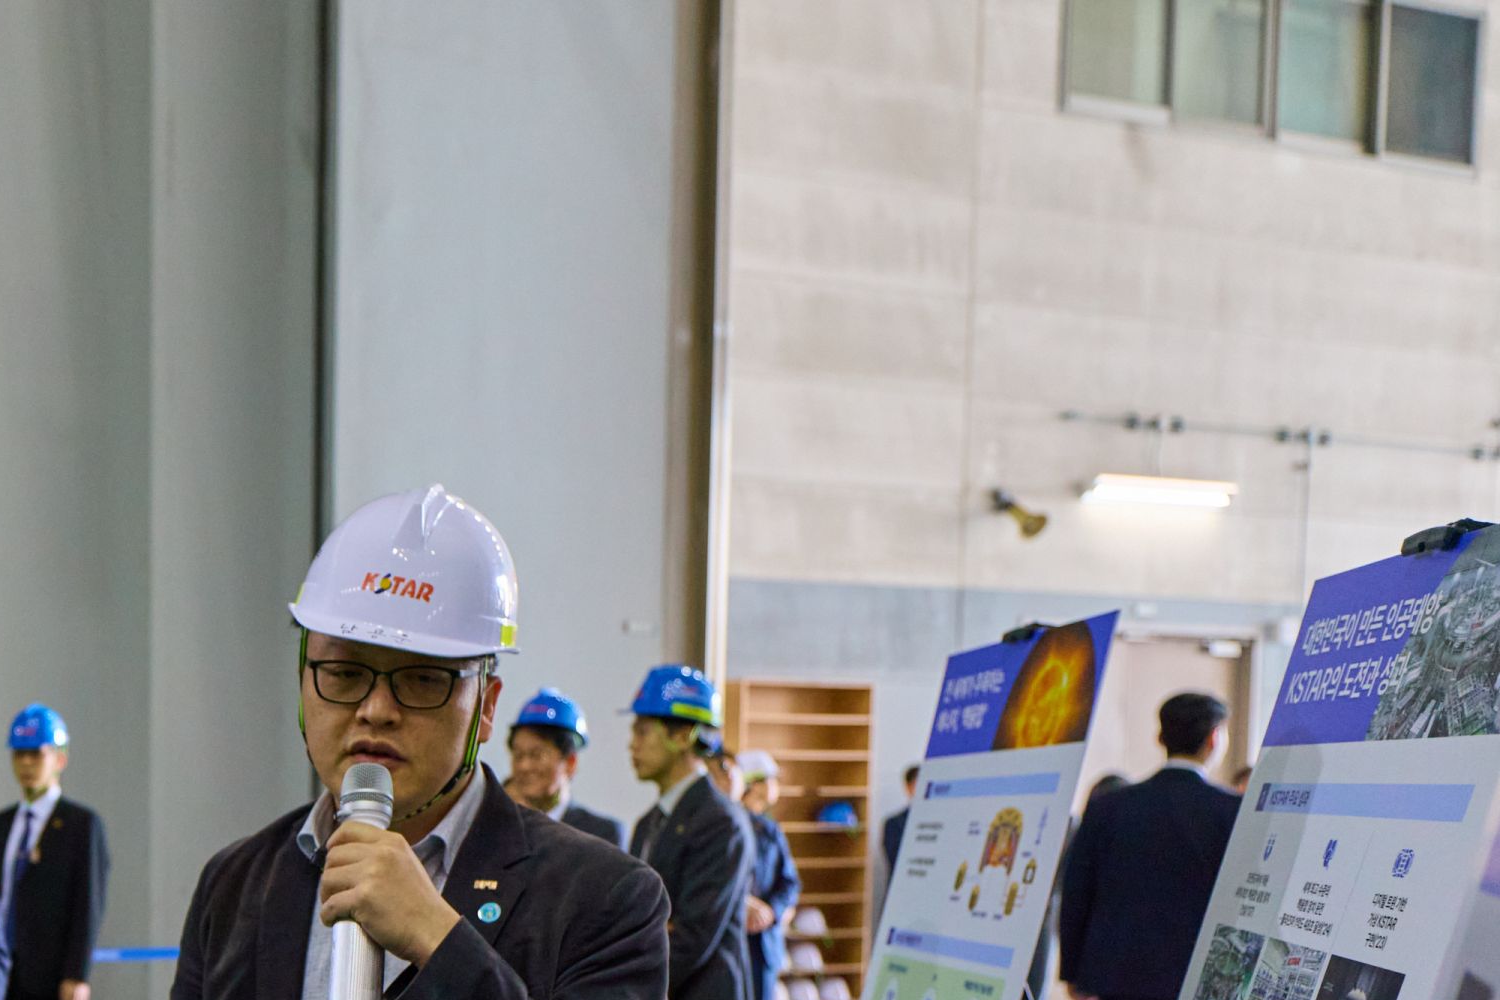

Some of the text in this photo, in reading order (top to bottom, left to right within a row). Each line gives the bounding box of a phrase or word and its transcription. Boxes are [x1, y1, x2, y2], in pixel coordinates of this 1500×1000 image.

[361, 572, 435, 604] KSTAR
[1302, 591, 1443, 656] 대한민국이 만든 인공태양
[1285, 651, 1412, 704] KSTAR의 도전과 성과
[1378, 916, 1397, 930] KSTAR
